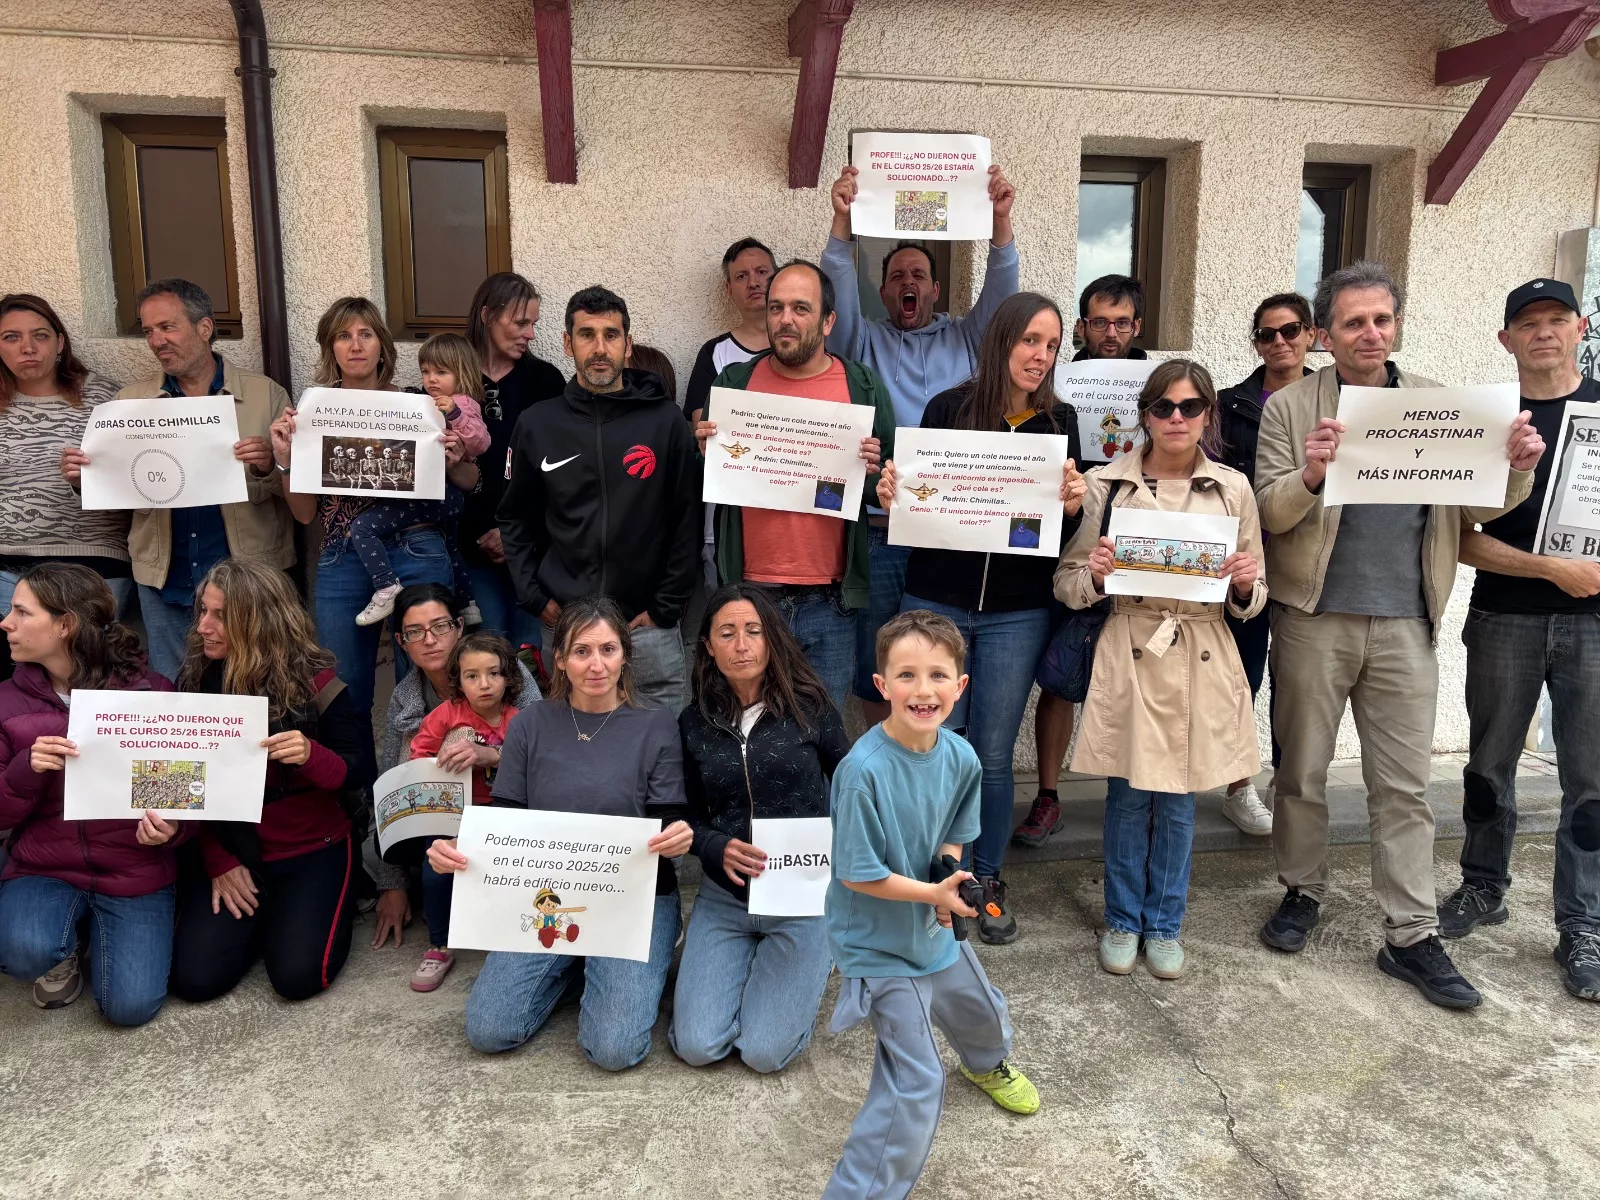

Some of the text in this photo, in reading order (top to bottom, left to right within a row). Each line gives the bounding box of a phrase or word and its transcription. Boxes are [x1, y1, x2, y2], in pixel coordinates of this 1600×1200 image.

[870, 151, 902, 159] PROFE!!!
[927, 152, 959, 160] DIJERON
[944, 162, 974, 171] ESTARÍA
[887, 174, 958, 182] SOLUCIONADO...??
[1066, 377, 1110, 386] Podemos
[1071, 391, 1084, 399] en
[1085, 391, 1095, 399] el
[1097, 393, 1124, 401] curso
[374, 410, 423, 420] CHIMILLAS
[1094, 406, 1128, 416] edificio
[1403, 410, 1460, 421] MENOS
[95, 415, 221, 429] OBRAS COLE CHIMILLAS
[731, 409, 755, 418] Pedrín:
[757, 412, 780, 421] Quiero
[791, 416, 807, 425] cole
[807, 419, 829, 428] nuevo
[830, 421, 838, 429] el
[838, 423, 852, 431] año
[311, 419, 427, 433] ESPERANDO LAS OBRAS...
[760, 423, 779, 431] viene
[796, 428, 834, 439] unicornio...
[1365, 428, 1485, 439] PROCRASTINAR
[1574, 428, 1600, 443] SE
[731, 430, 754, 439] Genio:
[763, 434, 796, 444] unicornio
[806, 439, 846, 451] imposible...
[763, 446, 782, 455] ¿Qué
[783, 447, 799, 455] cole
[944, 450, 969, 459] Quiero
[981, 452, 996, 460] cole
[1023, 454, 1031, 462] el
[1414, 448, 1424, 459] Y
[754, 454, 818, 469] Pedrín: Chimillas...
[948, 461, 968, 469] viene
[986, 463, 1027, 472] unicornio...
[147, 471, 167, 483] 0%
[723, 463, 746, 471] Genio:
[759, 466, 792, 477] unicornio
[793, 470, 816, 480] blanco
[823, 473, 832, 481] de
[833, 476, 847, 484] otro
[917, 472, 941, 480] Genio:
[951, 474, 986, 482] unicornio
[997, 476, 1041, 485] imposible...
[1357, 466, 1474, 481] MÁS INFORMAR
[952, 484, 971, 492] ¿Qué
[1571, 484, 1589, 493] algo
[942, 495, 1011, 505] Pedrín: Chimillas...
[909, 505, 934, 513] Genio:
[948, 508, 983, 516] unicornio
[1548, 532, 1575, 553] SE
[95, 713, 140, 722] PROFE!!!
[177, 715, 220, 724] DIJERON
[222, 717, 244, 725] QUE
[97, 727, 241, 737] EN EL CURSO 25/26 ESTARÍA
[119, 740, 219, 750] SOLUCIONADO...??
[484, 833, 632, 856] Podemos asegurar que
[493, 856, 620, 873] en el curso 2025/26
[769, 854, 830, 870] ¡¡¡BASTA
[483, 874, 625, 893] habrá edificio nuevo...
